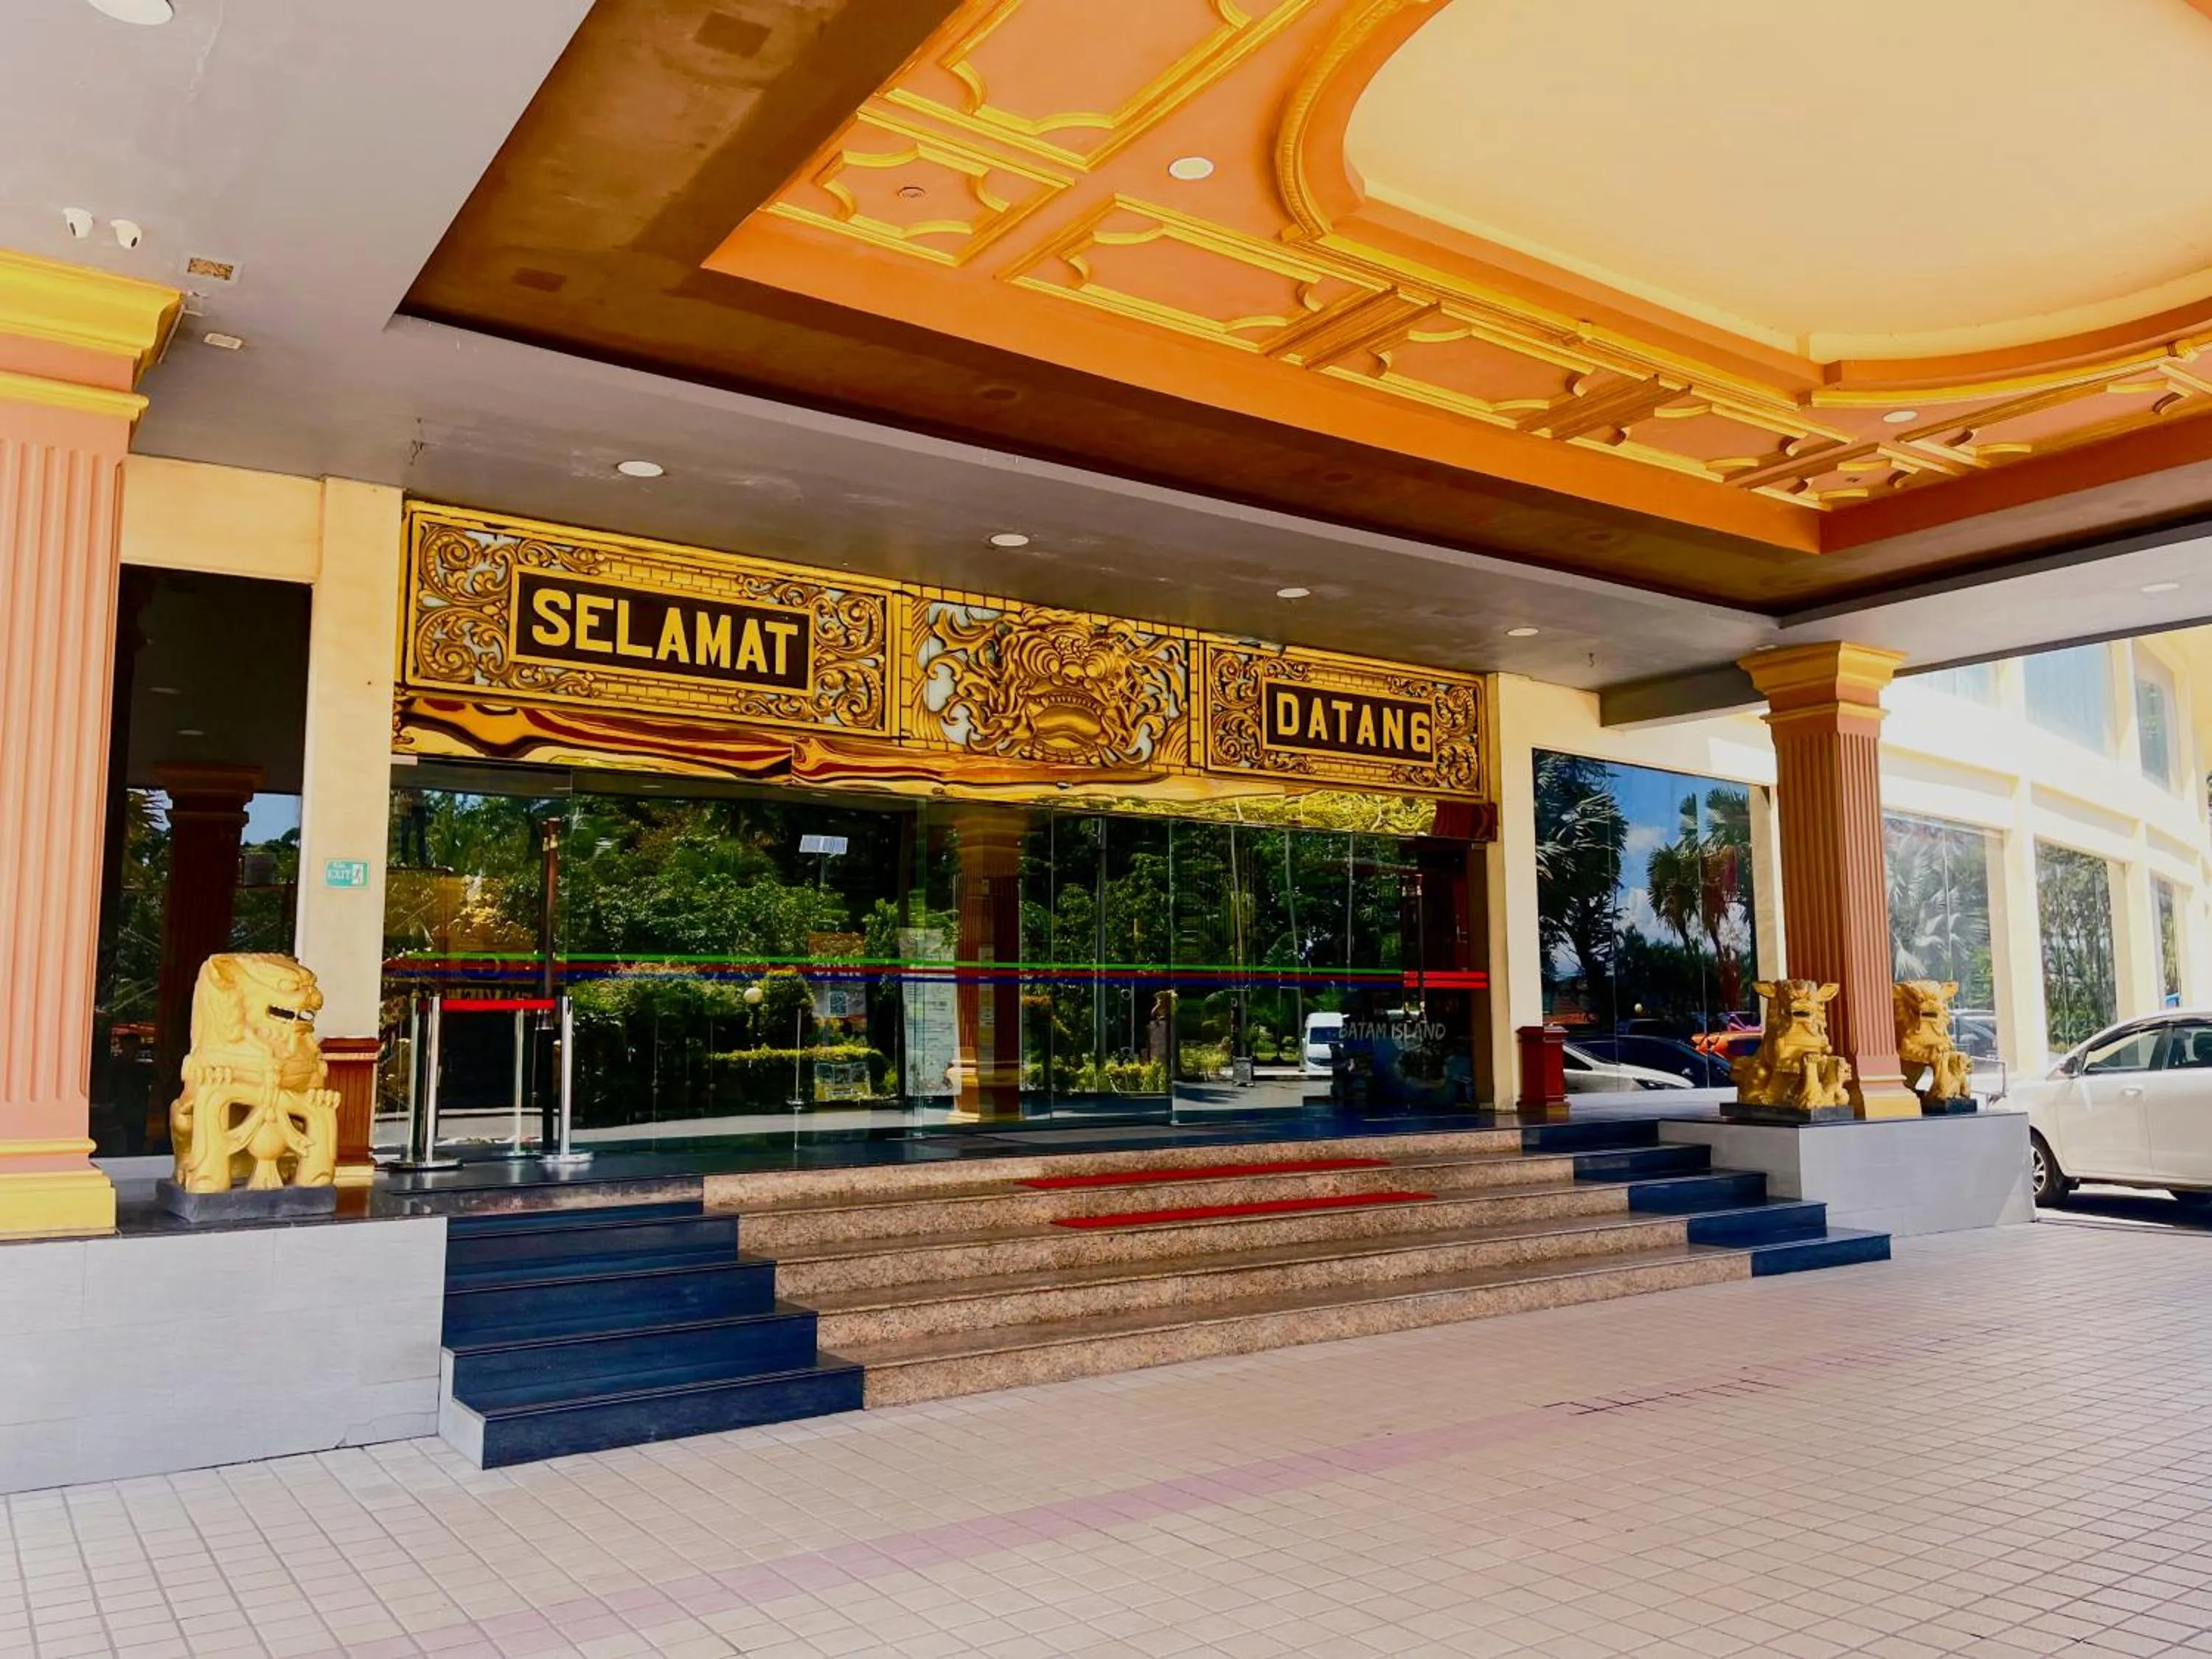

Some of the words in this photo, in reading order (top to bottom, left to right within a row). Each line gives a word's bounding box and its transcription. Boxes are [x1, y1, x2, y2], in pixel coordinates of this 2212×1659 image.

[531, 587, 799, 675] SELAMAT
[1276, 692, 1432, 754] DATANG
[1338, 1021, 1387, 1041] BATAM
[1391, 1020, 1447, 1041] ISLAND
